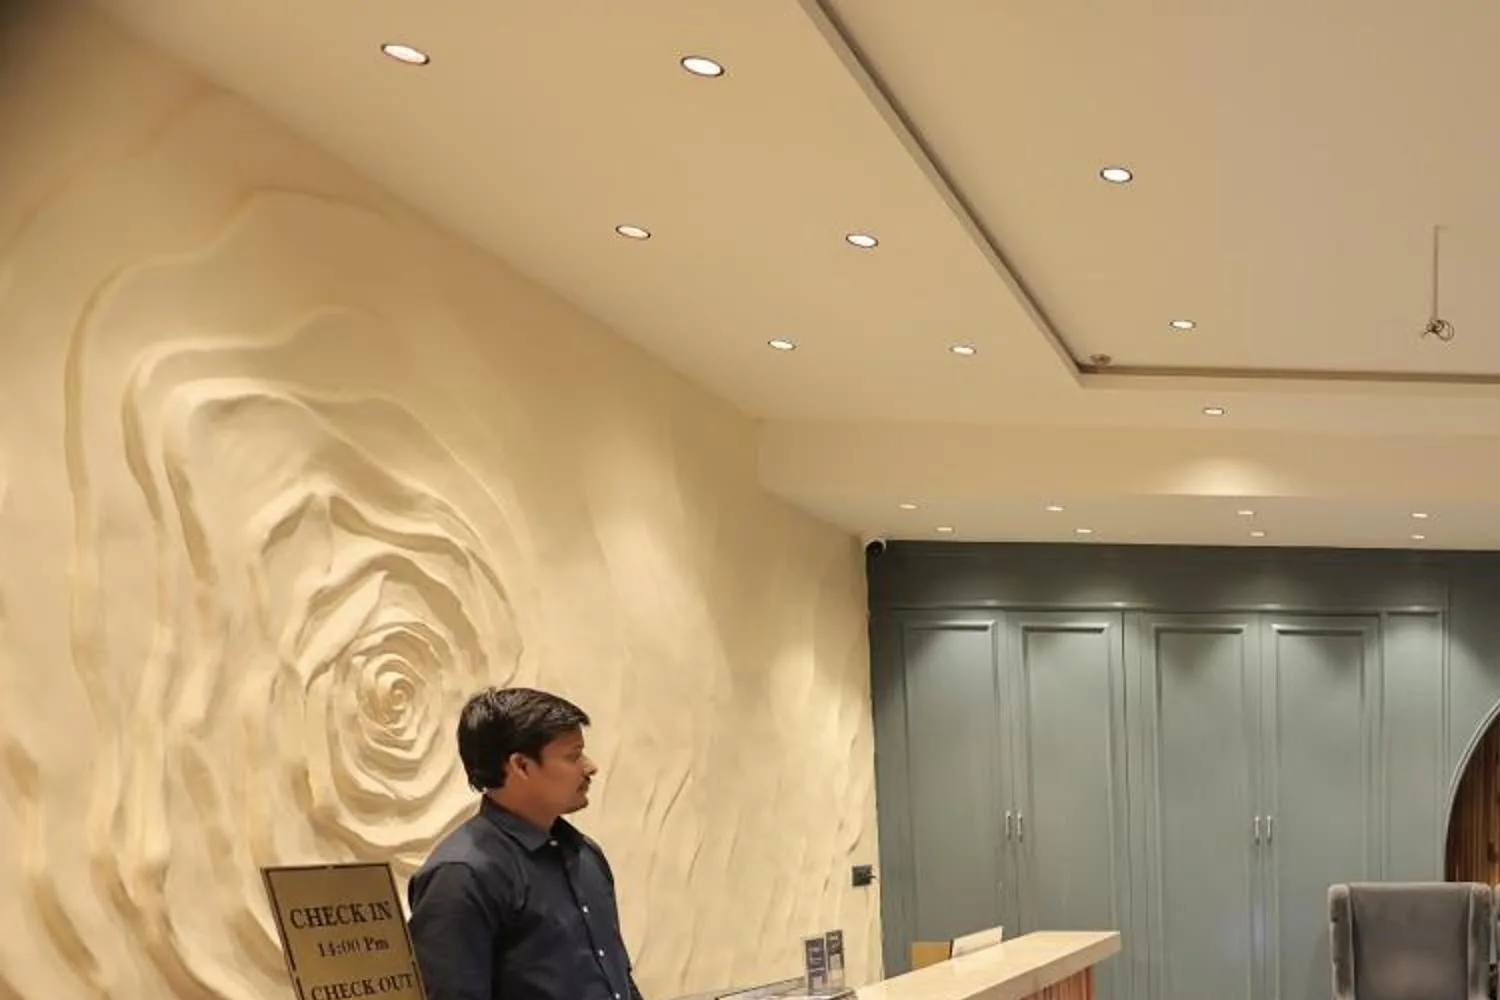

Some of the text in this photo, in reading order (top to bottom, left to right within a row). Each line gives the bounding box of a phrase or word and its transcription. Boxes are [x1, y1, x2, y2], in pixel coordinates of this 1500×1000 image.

[289, 901, 393, 930] CHECK IN
[379, 973, 414, 993] OUT
